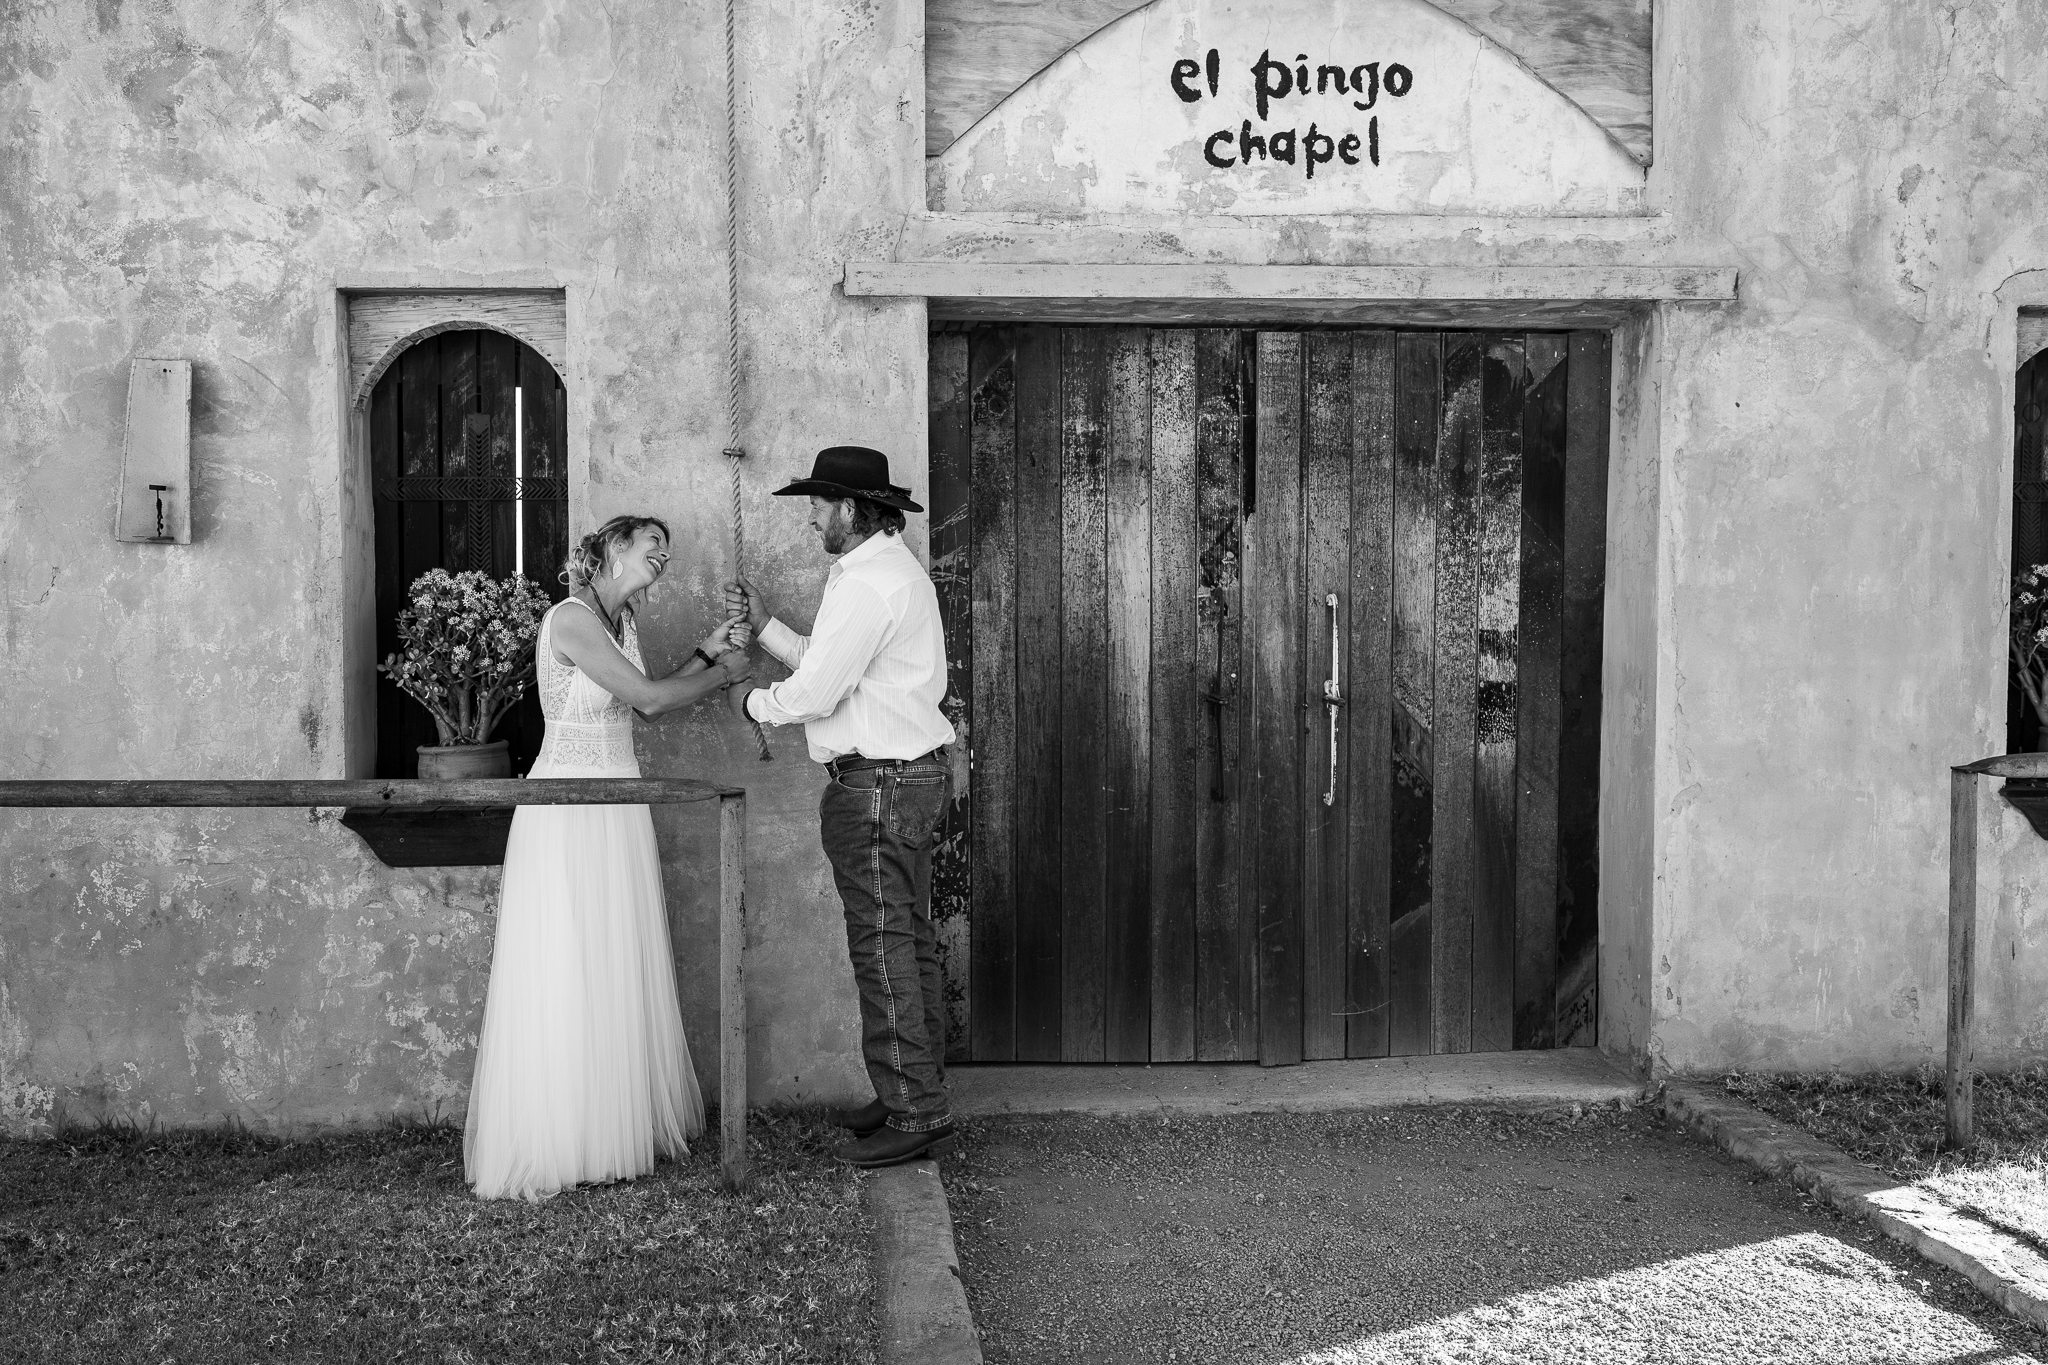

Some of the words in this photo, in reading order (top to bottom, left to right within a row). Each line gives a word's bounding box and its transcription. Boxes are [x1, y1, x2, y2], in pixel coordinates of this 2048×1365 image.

[1170, 48, 1221, 104] el
[1250, 48, 1414, 122] pingo
[1203, 115, 1380, 180] chapel
